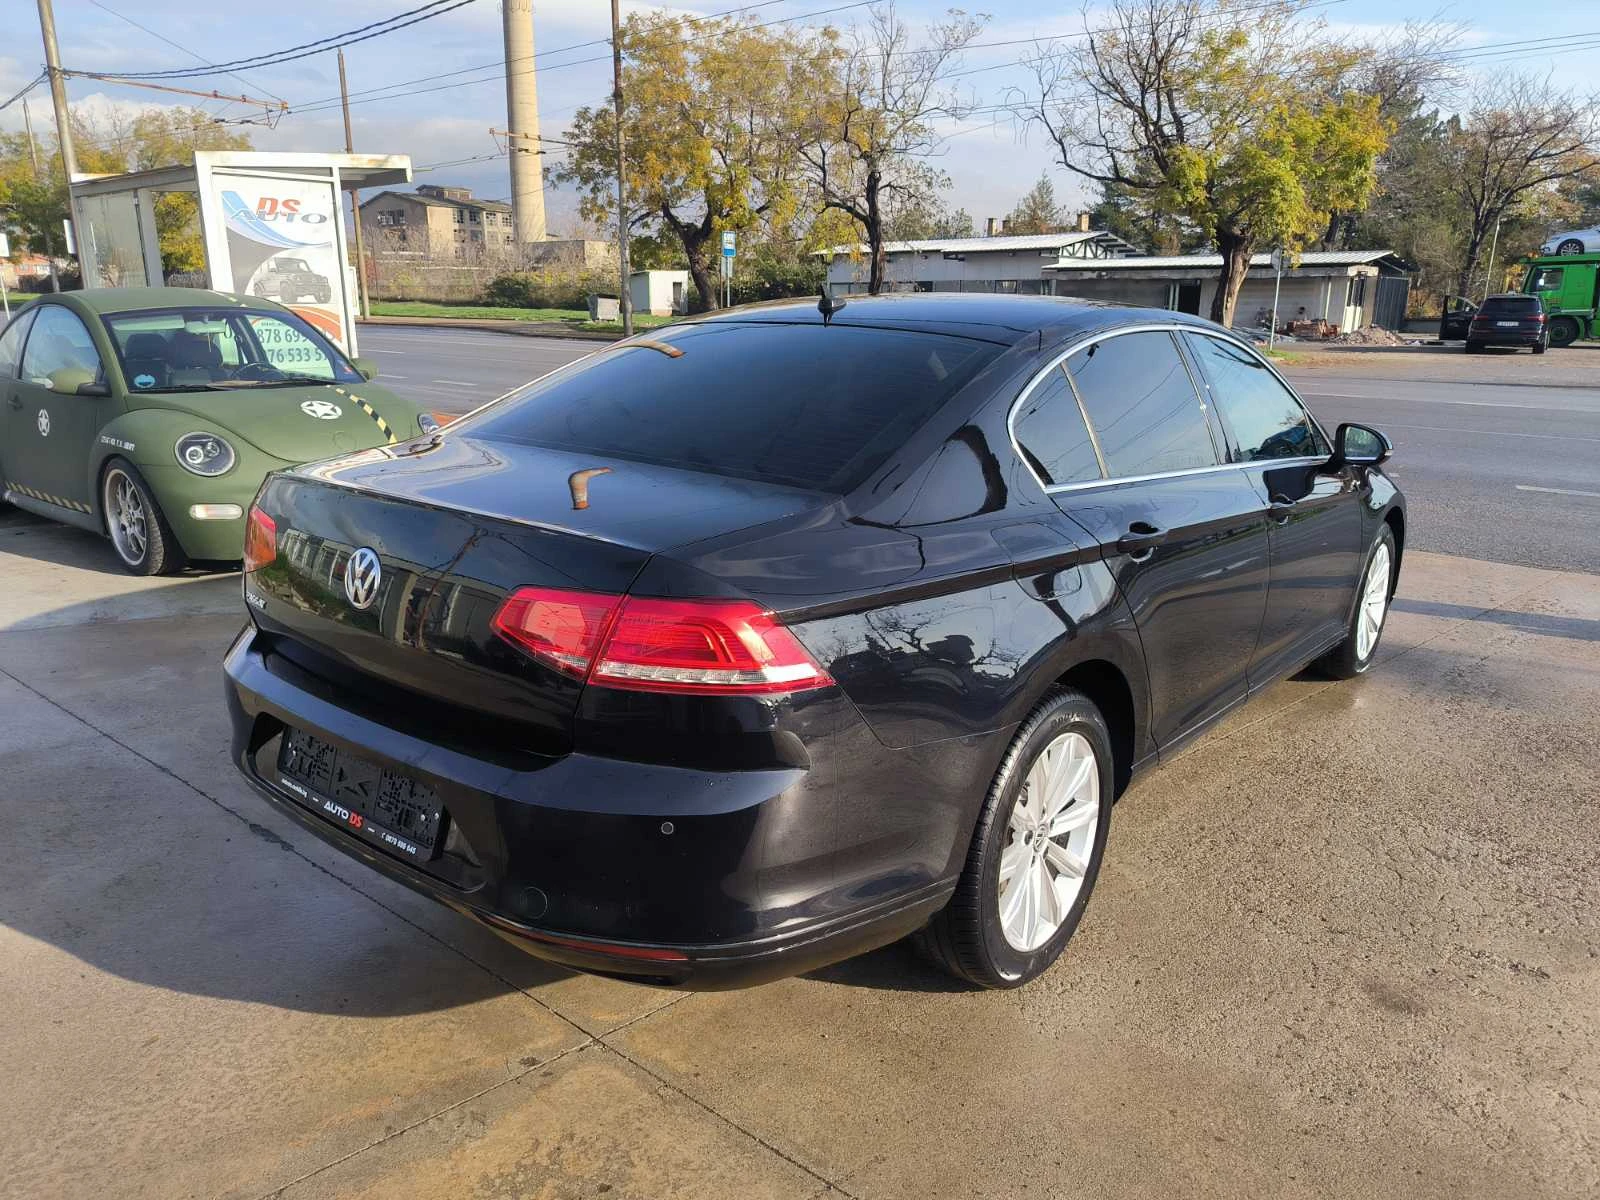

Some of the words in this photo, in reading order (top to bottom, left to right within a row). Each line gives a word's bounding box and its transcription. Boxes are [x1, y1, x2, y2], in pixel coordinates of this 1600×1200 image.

[257, 197, 302, 217] DS
[287, 347, 311, 362] 533
[324, 801, 349, 820] AUTO
[349, 811, 363, 829] DS
